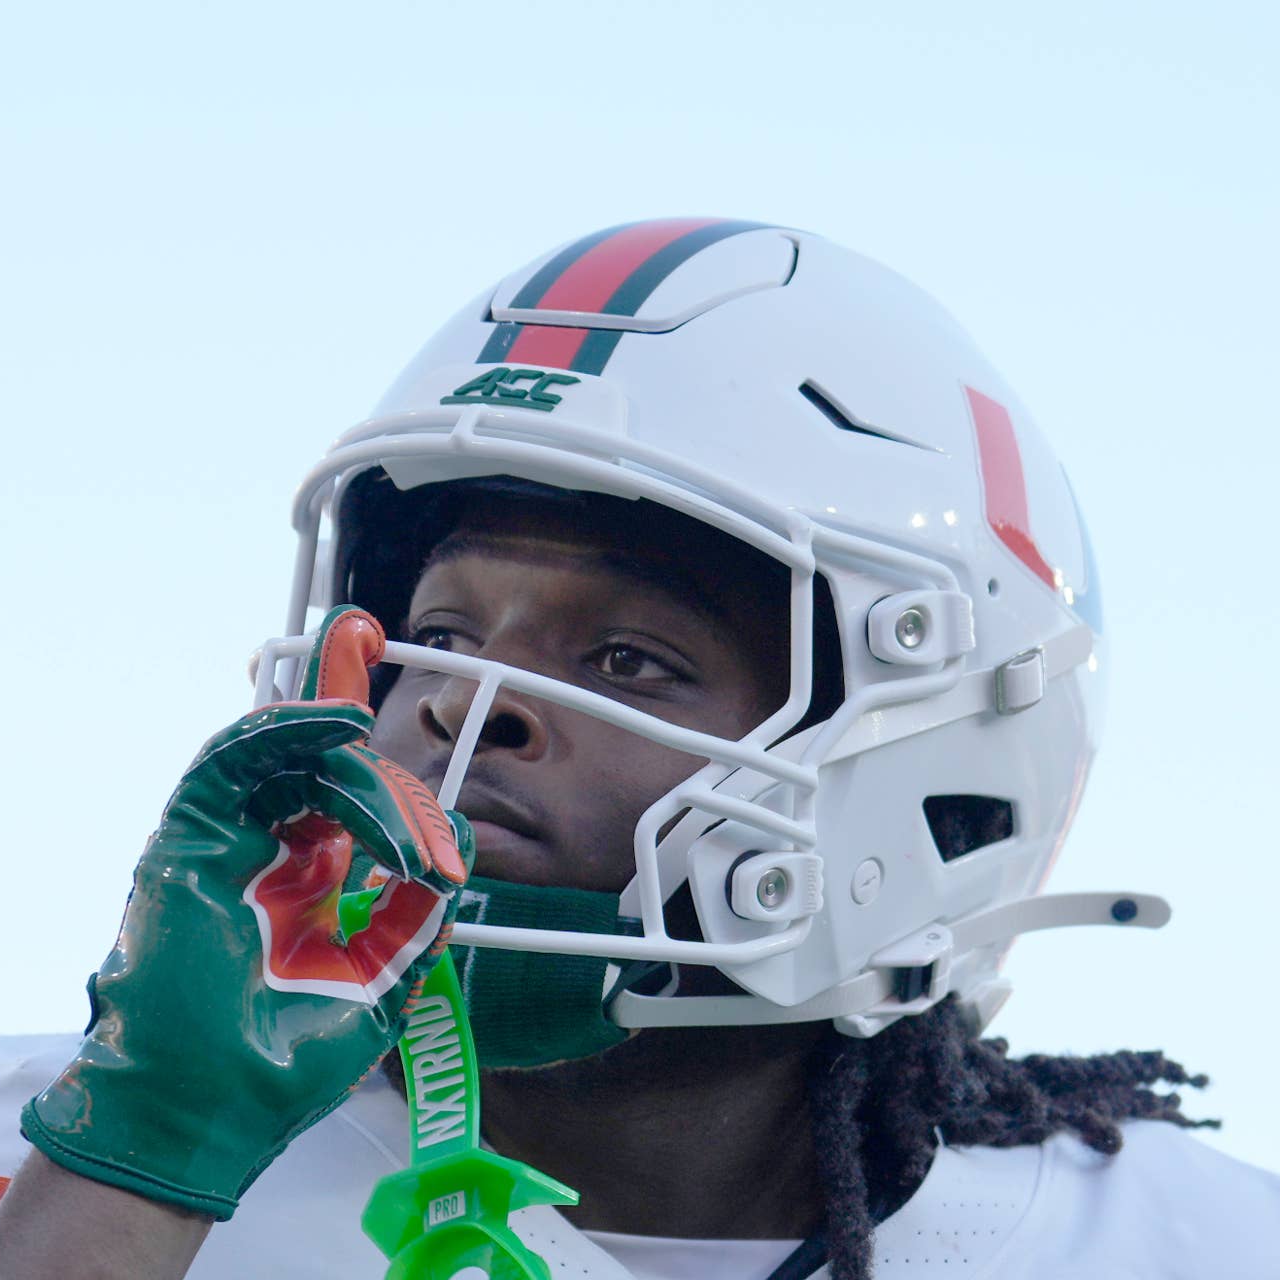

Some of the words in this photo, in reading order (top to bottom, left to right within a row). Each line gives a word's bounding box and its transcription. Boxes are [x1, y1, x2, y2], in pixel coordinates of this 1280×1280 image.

[452, 366, 582, 405] ACC
[405, 994, 467, 1150] NXTRND
[434, 1195, 459, 1221] PRO
